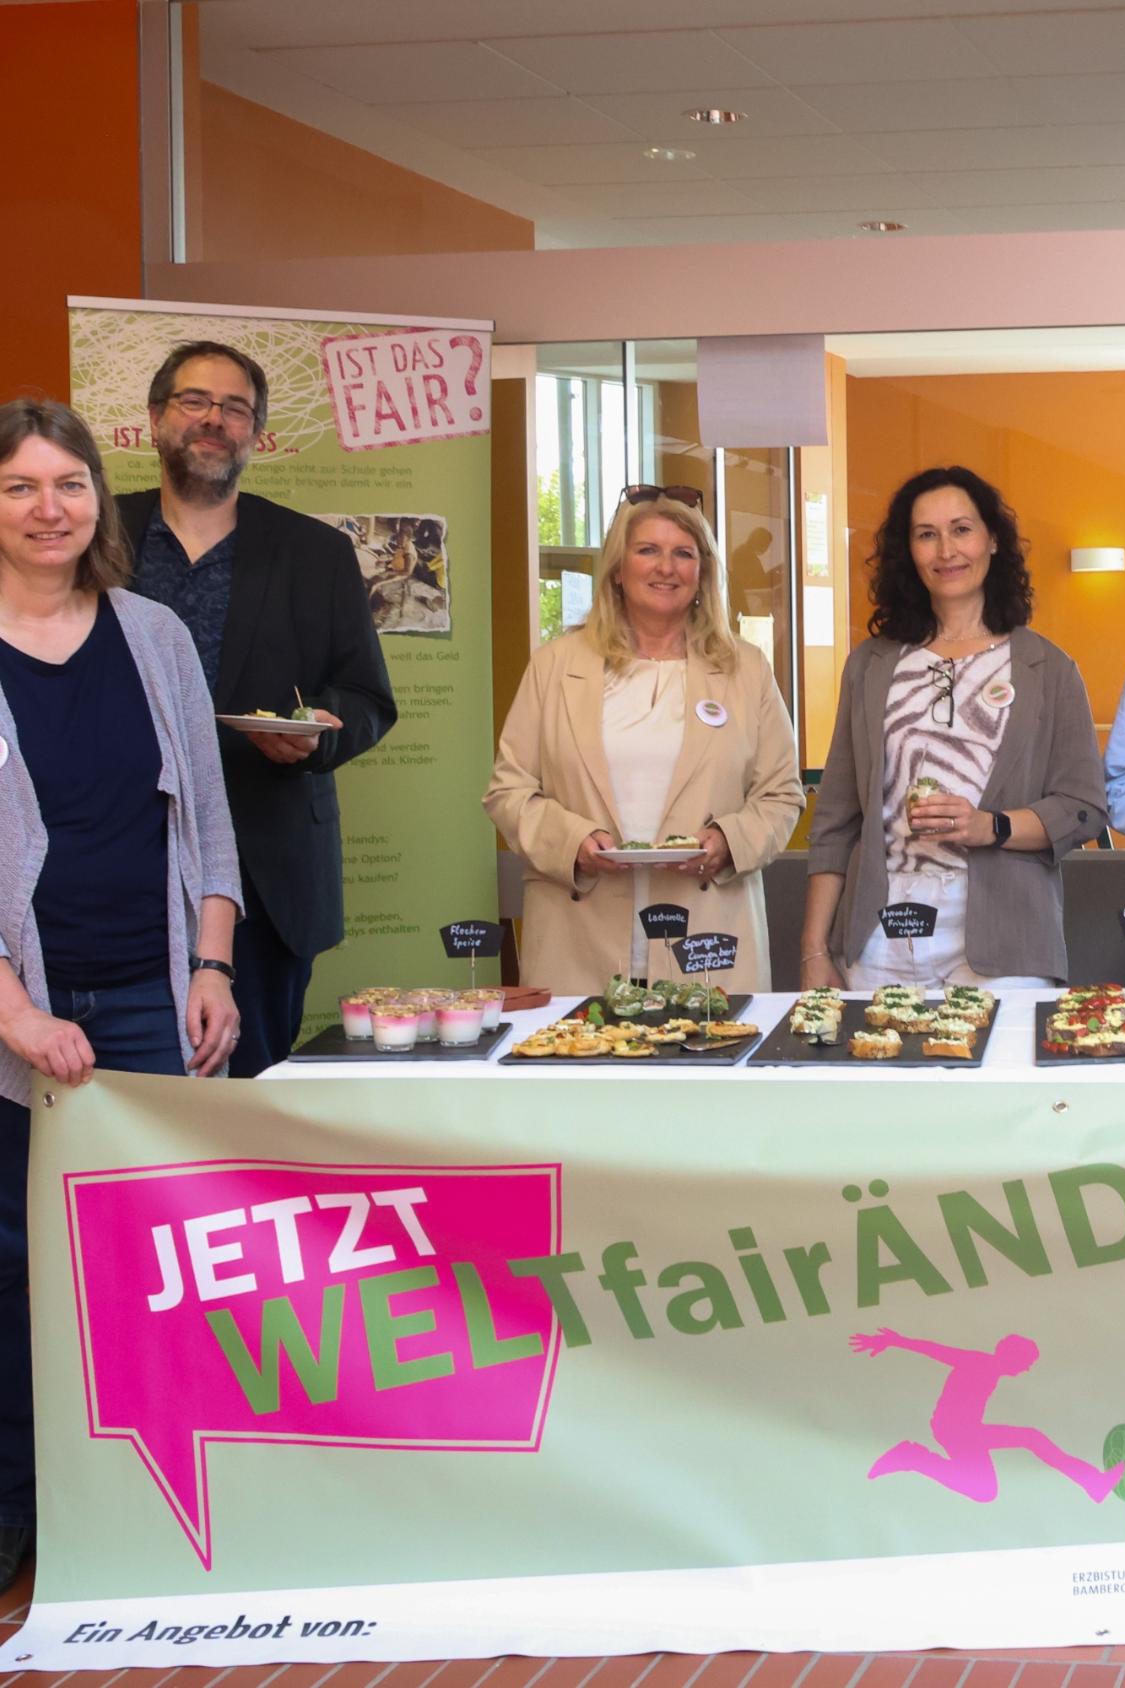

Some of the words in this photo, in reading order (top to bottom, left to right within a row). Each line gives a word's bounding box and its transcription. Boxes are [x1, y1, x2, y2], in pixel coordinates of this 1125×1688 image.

[336, 346, 377, 380] IST
[391, 338, 444, 373] DAS
[113, 427, 143, 448] IST
[146, 1186, 437, 1313] JETZT
[62, 1620, 123, 1644] Ein
[125, 1614, 291, 1645] Angebot
[299, 1619, 378, 1638] von:
